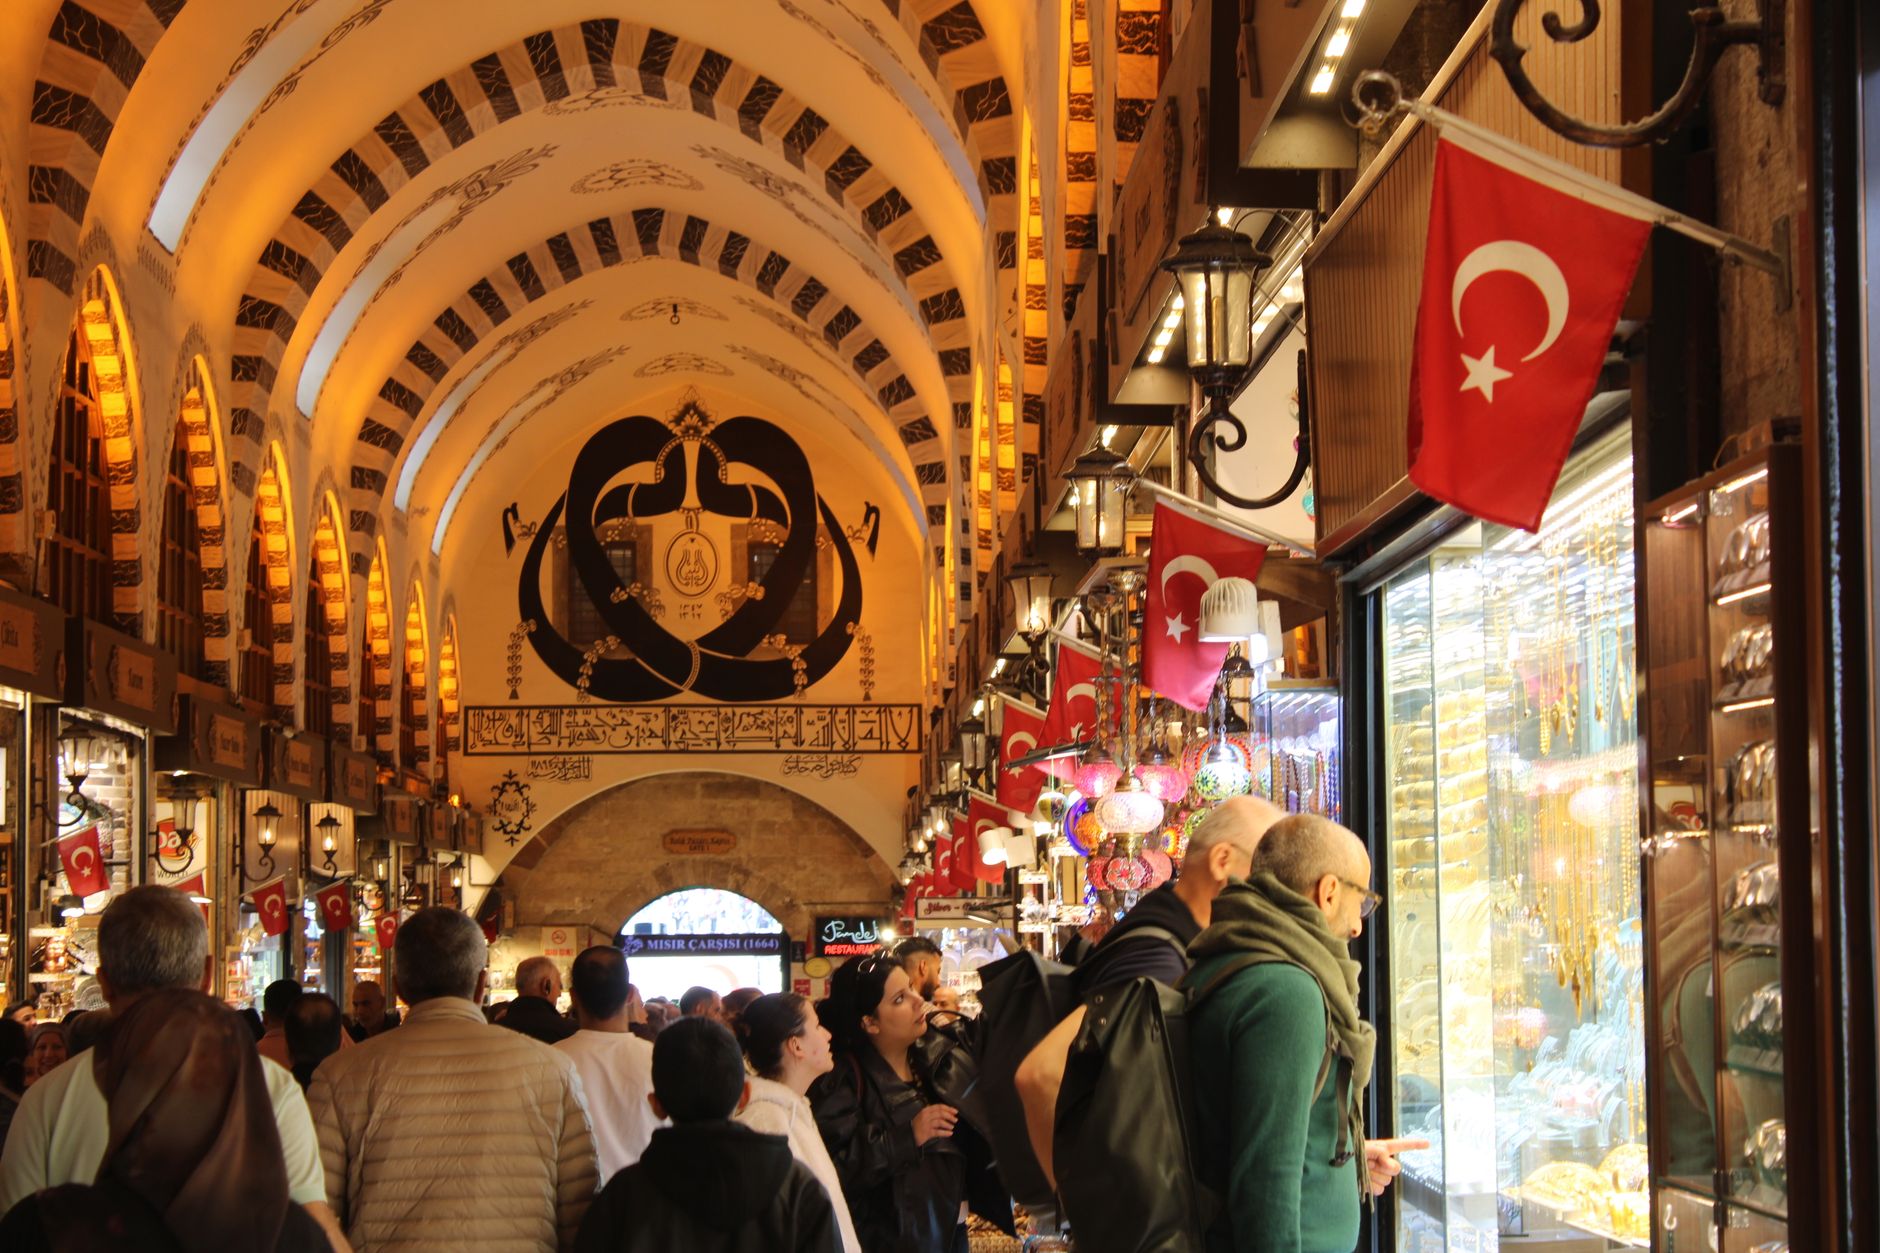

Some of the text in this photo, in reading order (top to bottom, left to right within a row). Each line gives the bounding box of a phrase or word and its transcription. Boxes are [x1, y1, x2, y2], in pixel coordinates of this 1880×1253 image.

[647, 938, 779, 951] MISIR ÇARŞISI (1664)
